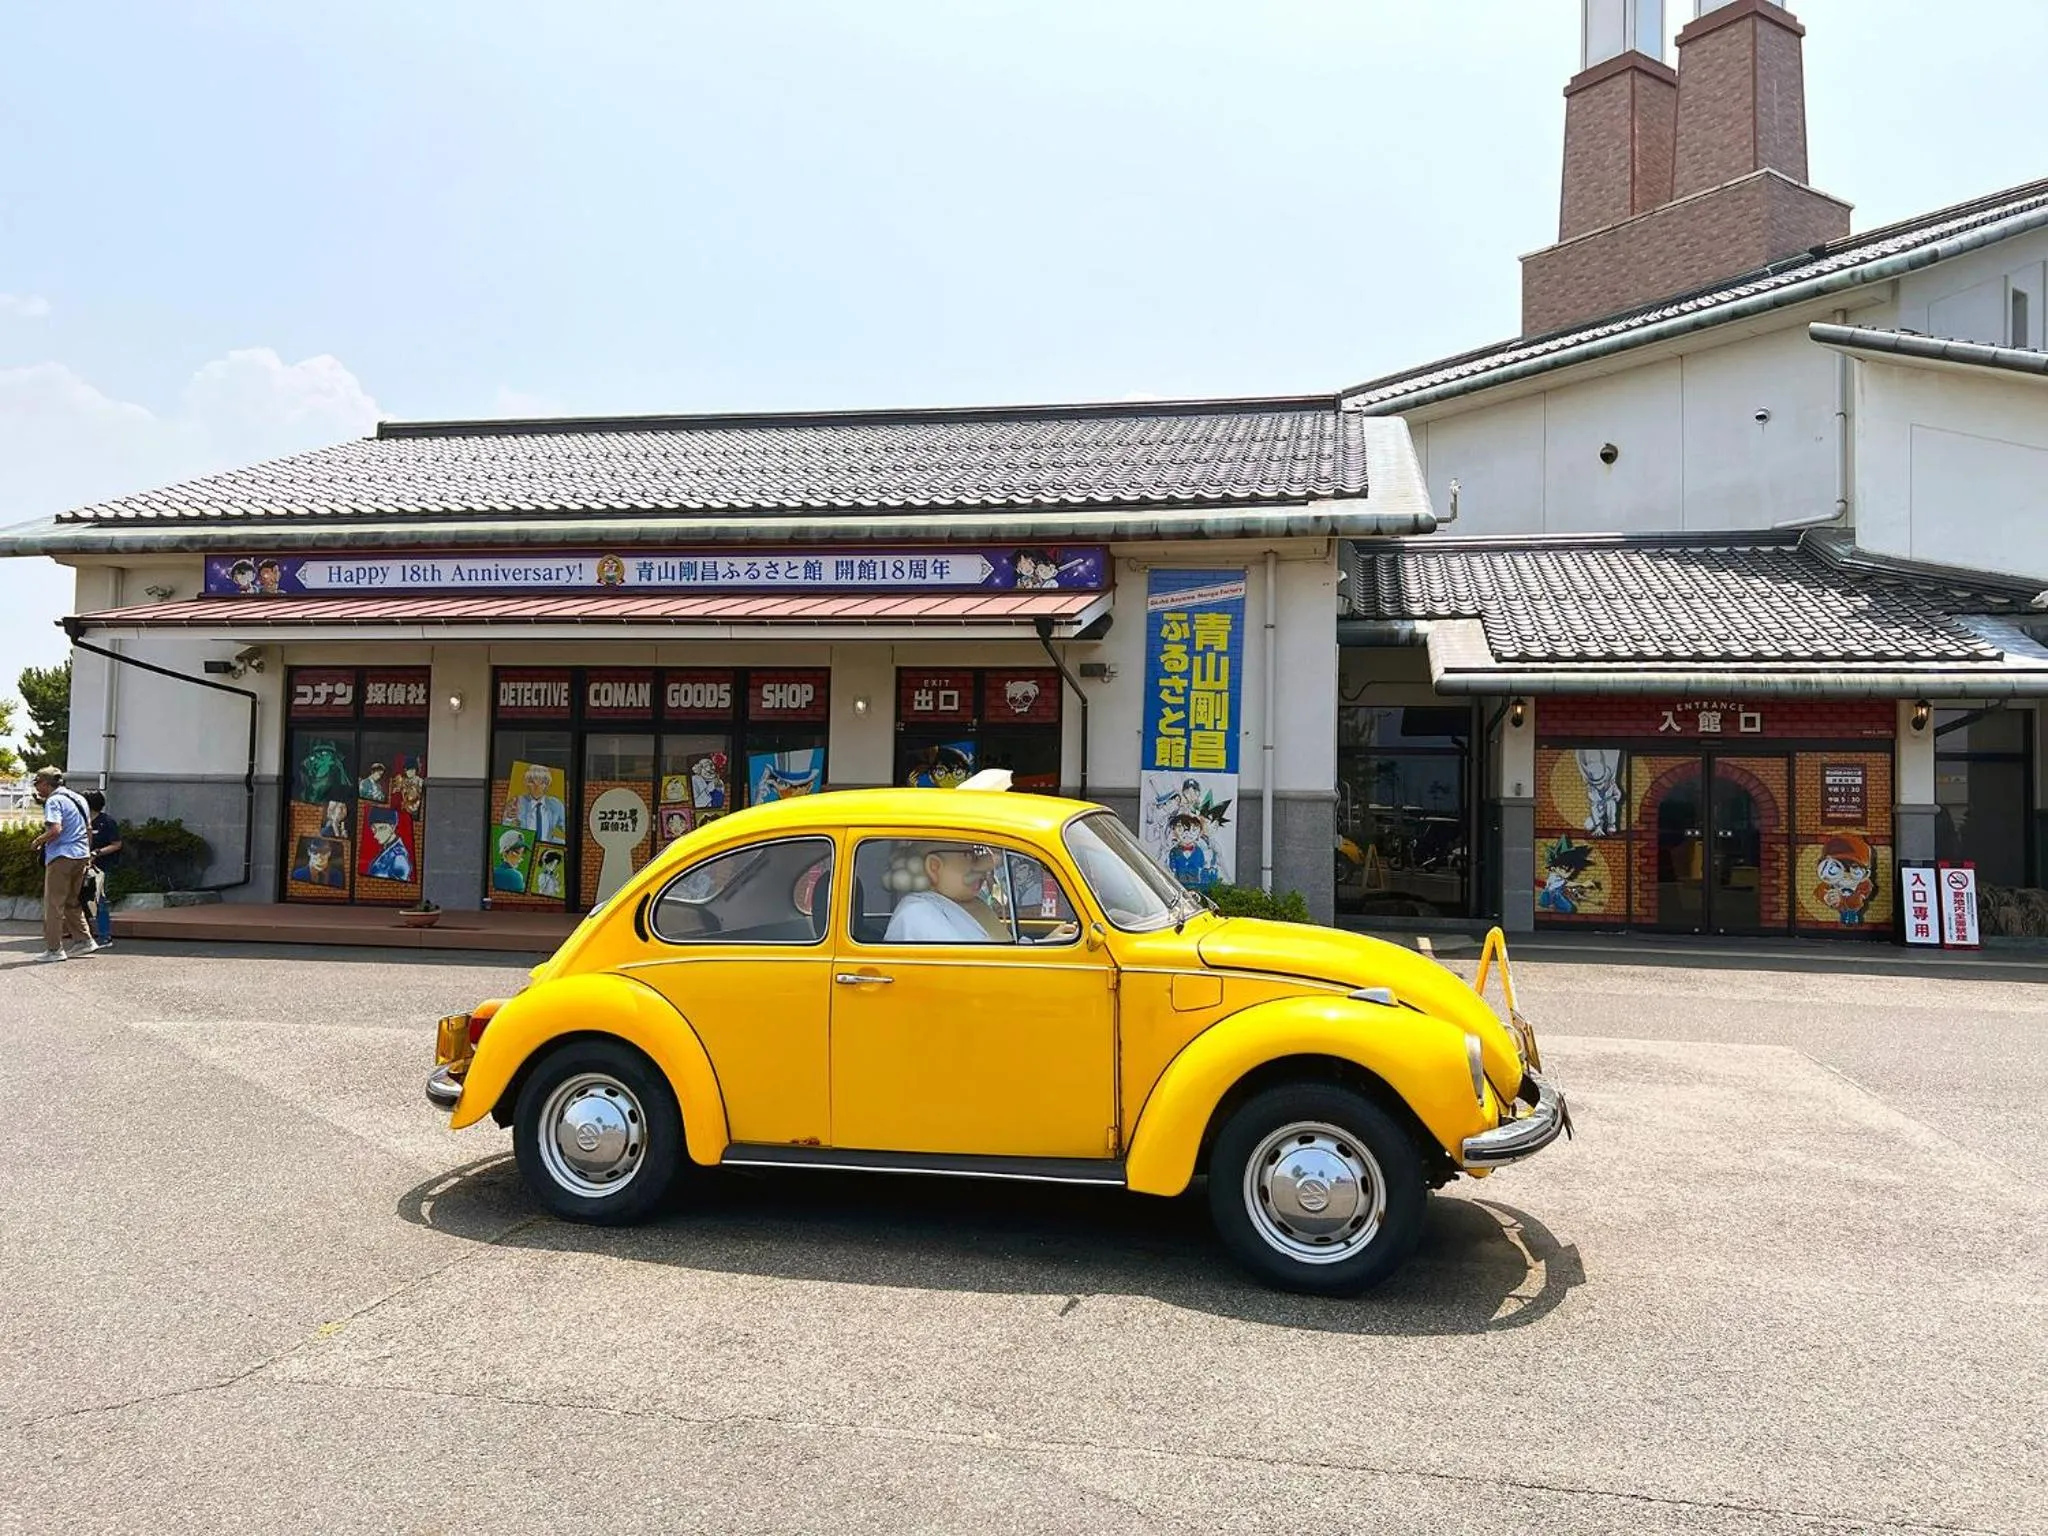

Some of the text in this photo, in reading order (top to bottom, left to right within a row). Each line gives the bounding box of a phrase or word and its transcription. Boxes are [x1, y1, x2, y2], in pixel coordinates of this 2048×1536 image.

[327, 561, 584, 585] Happy 18th Anniversary!
[635, 557, 952, 582] 青山剛昌ふるさと館 開館18周年
[293, 682, 427, 705] コナン 探偵社
[923, 679, 950, 687] EXIT
[1155, 612, 1191, 768] ふるさと館
[1189, 612, 1233, 770] 青山剛昌
[499, 682, 815, 709] DETECTIVE CONAN GOODS SHOP
[913, 689, 959, 711] 出口
[1676, 701, 1745, 712] ENTRANCE
[1659, 711, 1761, 733] 入館口
[598, 809, 627, 820] コナン
[1911, 872, 1929, 938] 入口専用
